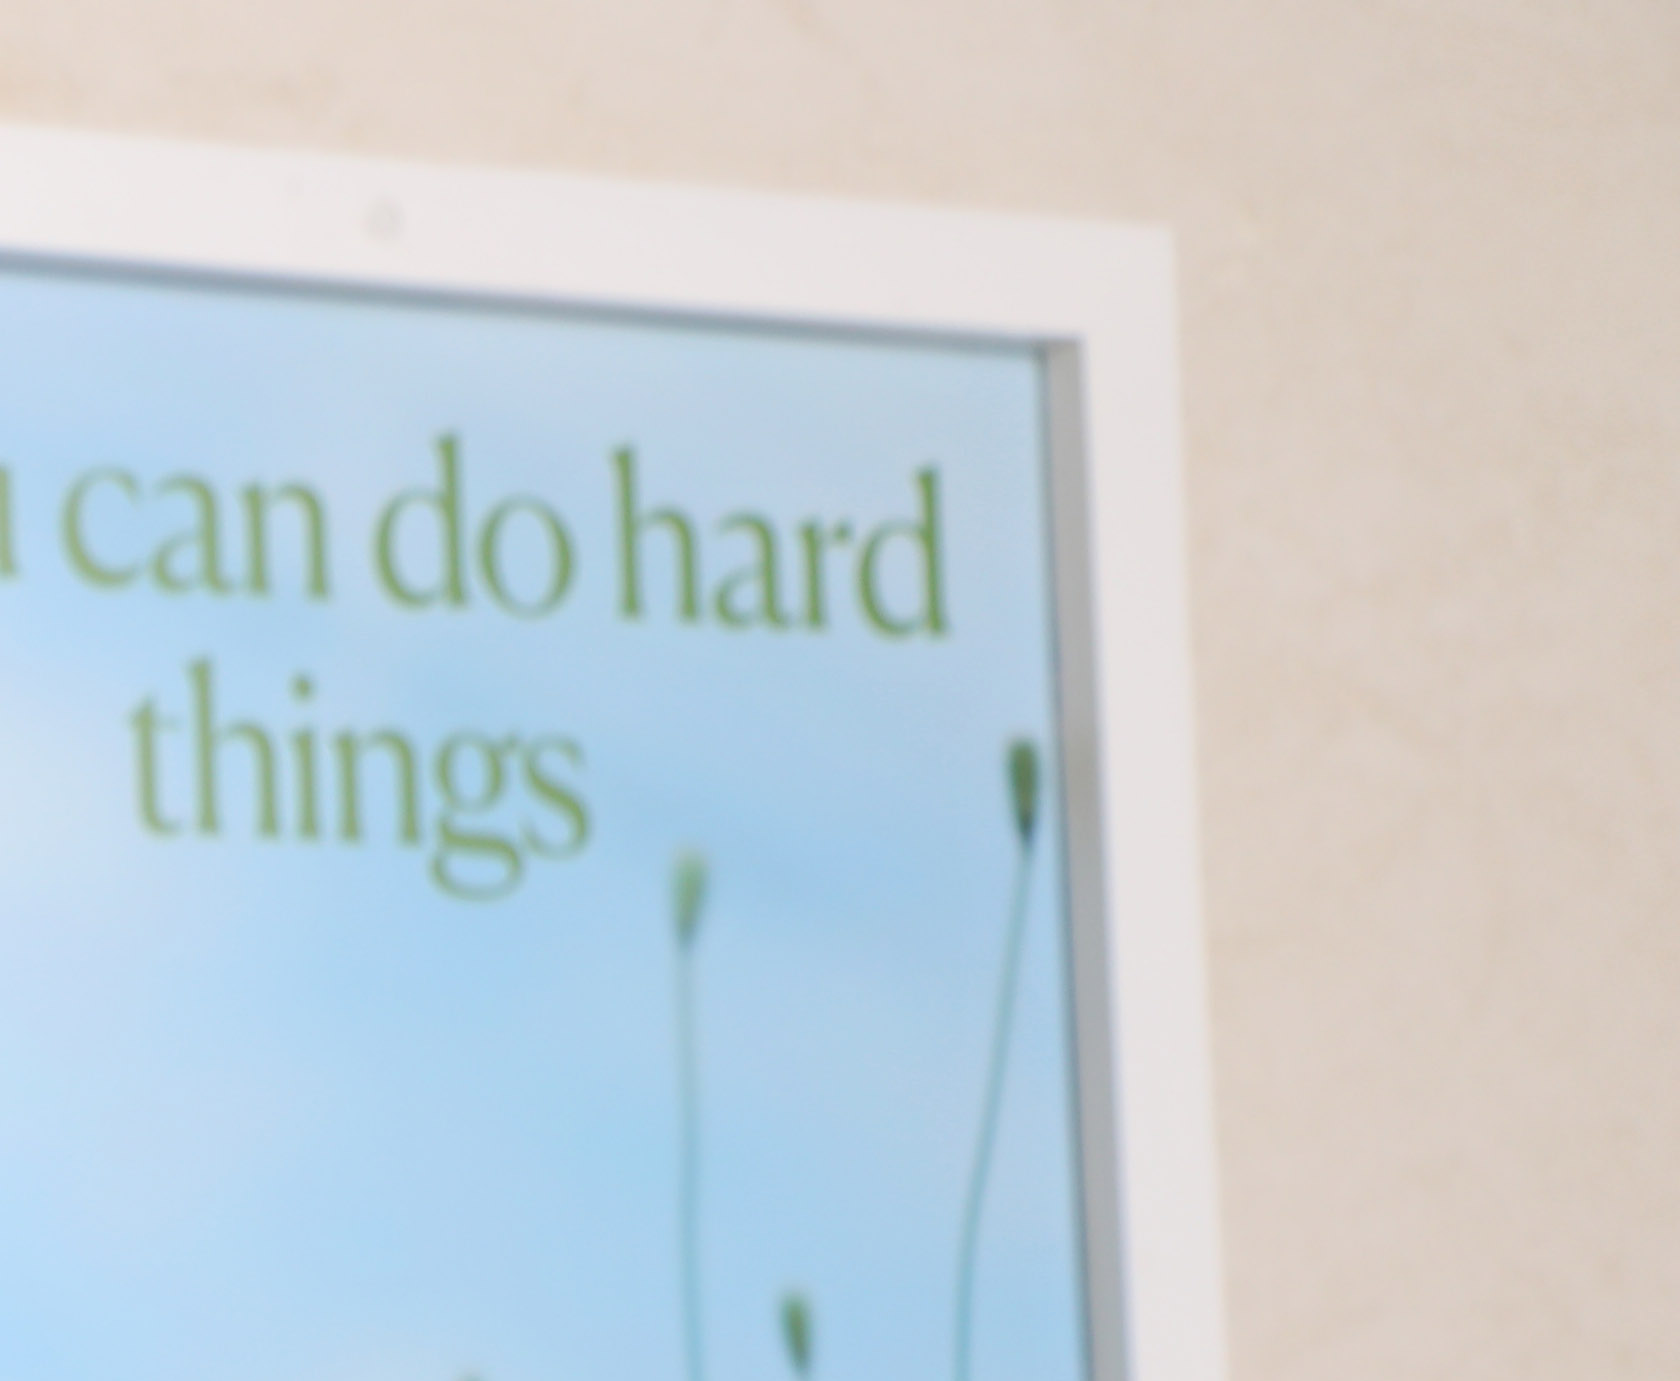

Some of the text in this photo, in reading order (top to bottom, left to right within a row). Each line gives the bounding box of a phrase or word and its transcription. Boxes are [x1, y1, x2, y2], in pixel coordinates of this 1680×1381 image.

[56, 463, 334, 603] can
[365, 430, 580, 618] do
[605, 442, 952, 643] hard
[126, 656, 592, 902] things
